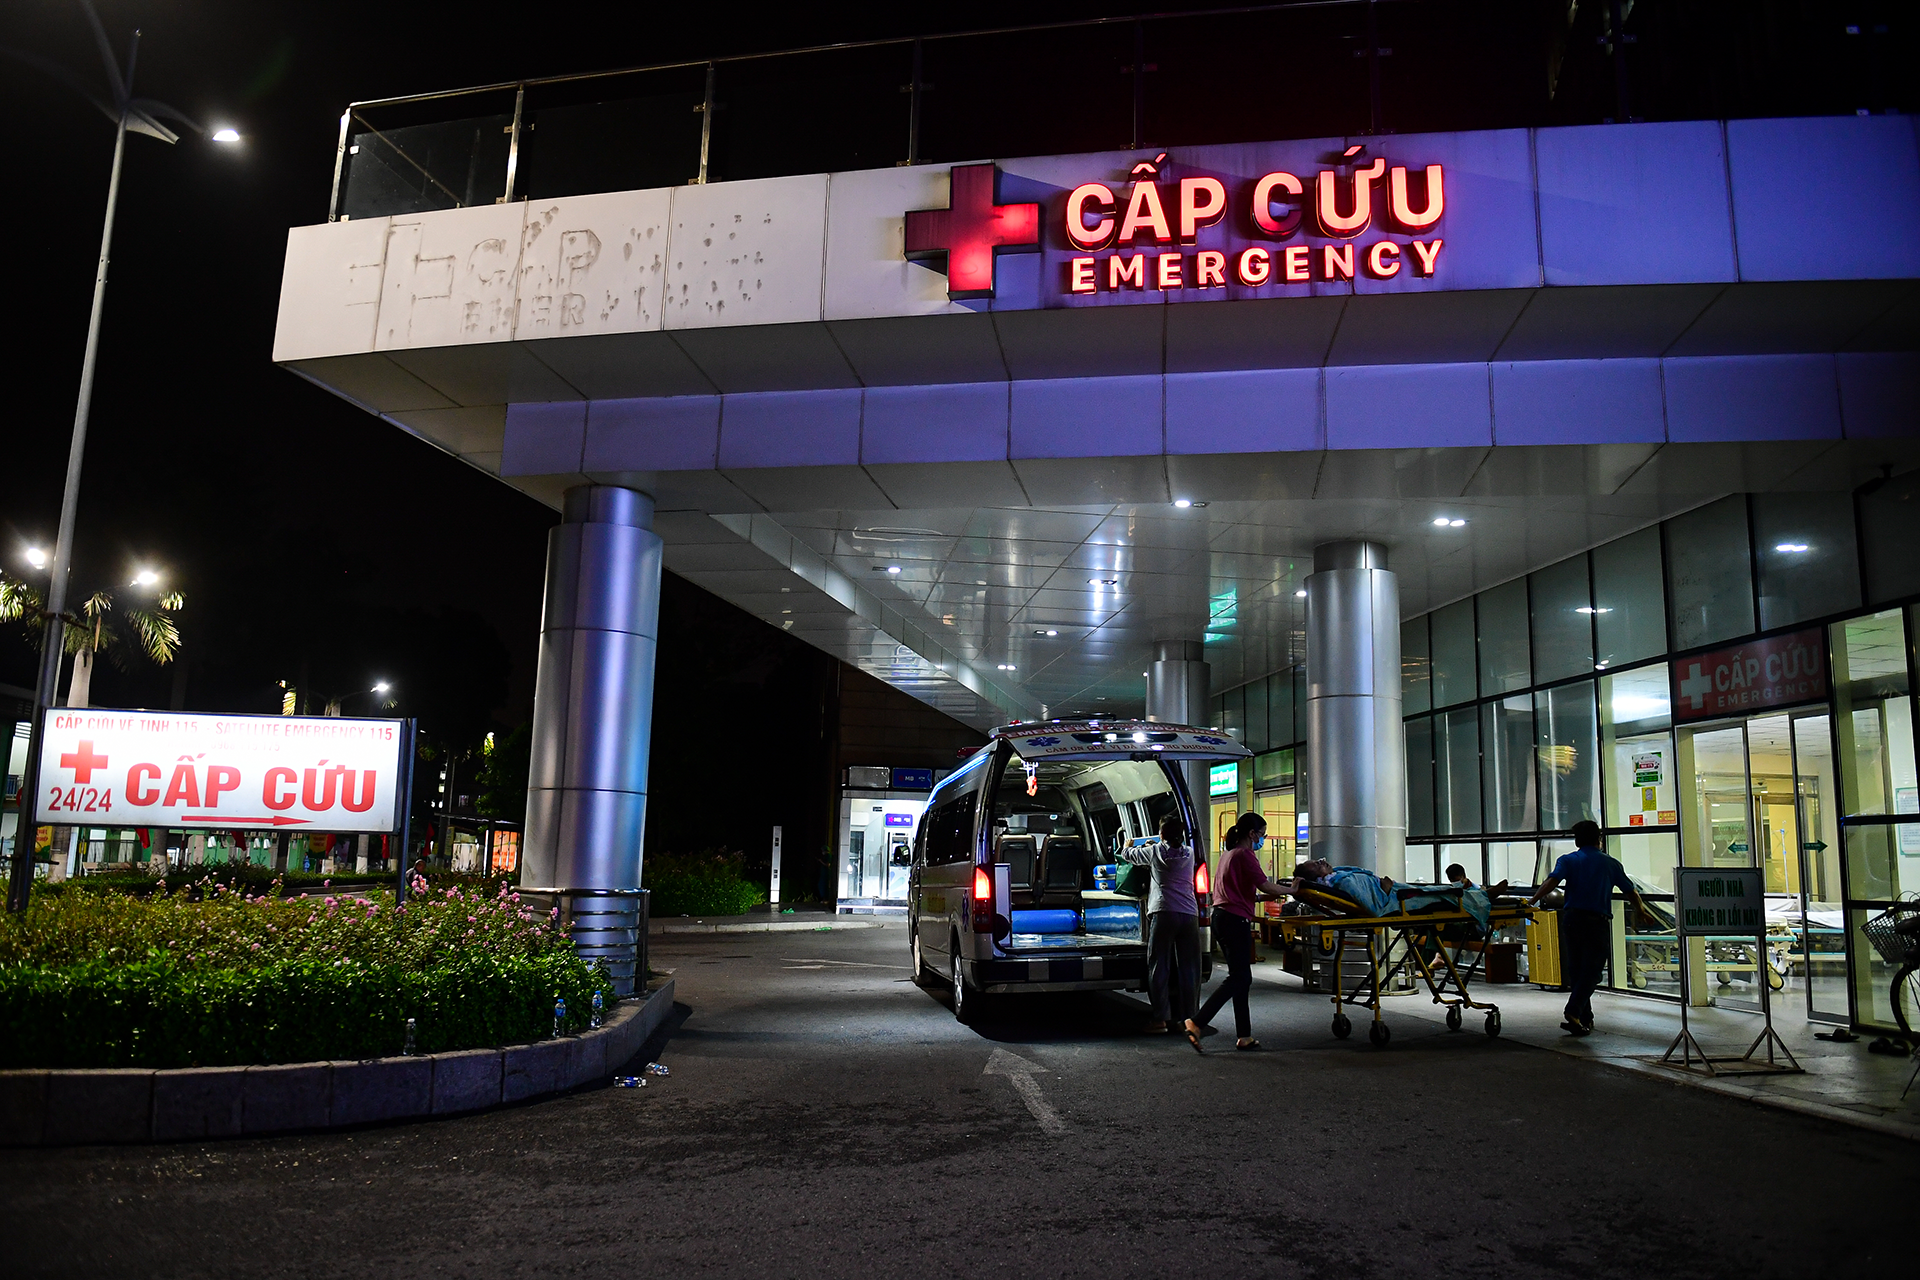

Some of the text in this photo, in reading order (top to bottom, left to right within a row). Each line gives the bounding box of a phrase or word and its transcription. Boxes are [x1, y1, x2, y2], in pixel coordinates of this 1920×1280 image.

[1066, 145, 1445, 250] CẤP CỨU
[1071, 239, 1443, 295] EMERGENCY
[1715, 642, 1820, 692] CẤP CỨU
[1718, 679, 1821, 707] EMERGENCY
[55, 711, 83, 729] CẤP
[215, 722, 280, 737] SATELLITE
[284, 724, 365, 739] EMERGENCY
[370, 727, 393, 741] 115
[124, 752, 377, 813] CẤP CỨU
[48, 786, 112, 813] 24/24
[1698, 877, 1744, 897] NGƯỜI NHÀ
[1684, 906, 1714, 926] KHÔNG
[1728, 903, 1741, 926] LỐI
[1743, 906, 1759, 926] NÀY
